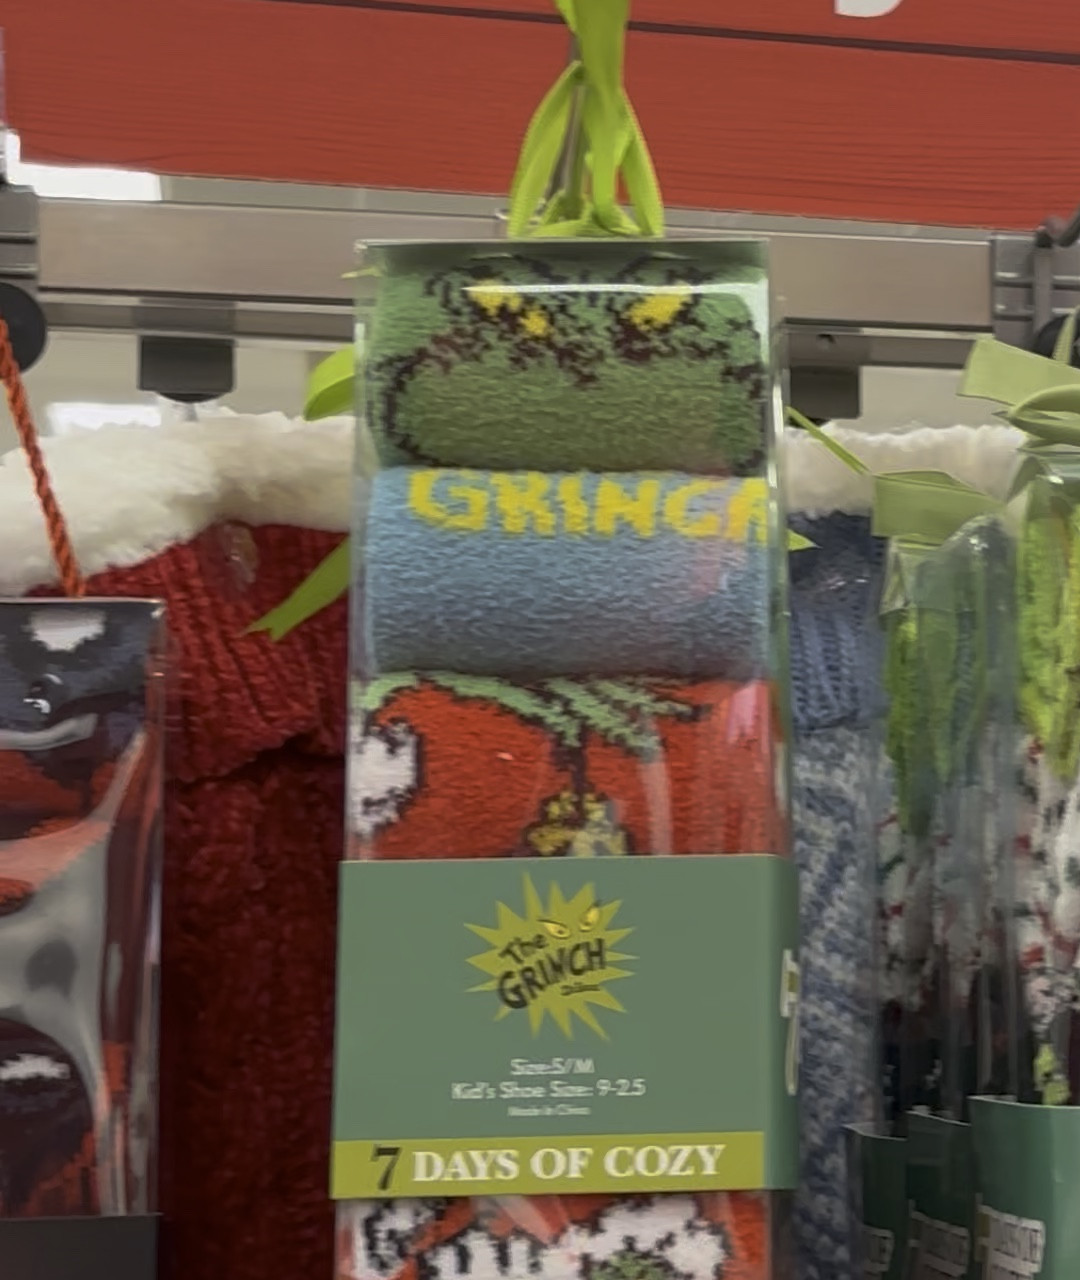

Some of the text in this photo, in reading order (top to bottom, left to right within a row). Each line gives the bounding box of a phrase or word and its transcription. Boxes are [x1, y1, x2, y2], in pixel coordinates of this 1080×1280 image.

[498, 934, 549, 964] The
[498, 938, 606, 1010] GRINCH
[499, 1081, 545, 1099] Shoe
[369, 1144, 726, 1191] 7 DAYS OF COZY
